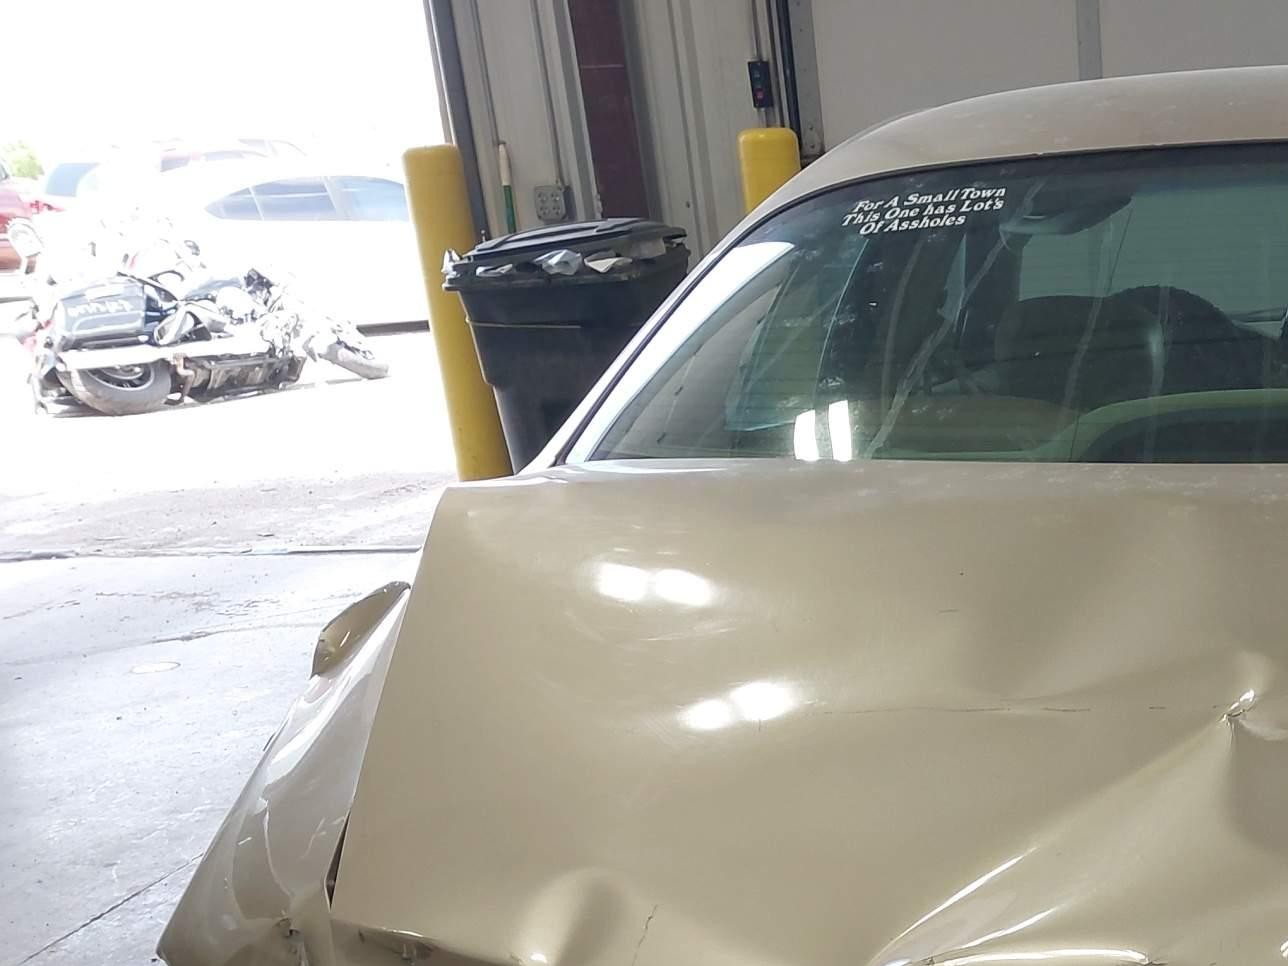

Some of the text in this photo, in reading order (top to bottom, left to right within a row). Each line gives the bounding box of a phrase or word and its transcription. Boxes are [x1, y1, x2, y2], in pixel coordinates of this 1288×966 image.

[842, 198, 1004, 227] This One has Lot's
[853, 187, 1006, 213] For A Small Town
[859, 214, 967, 236] Of Assholes
